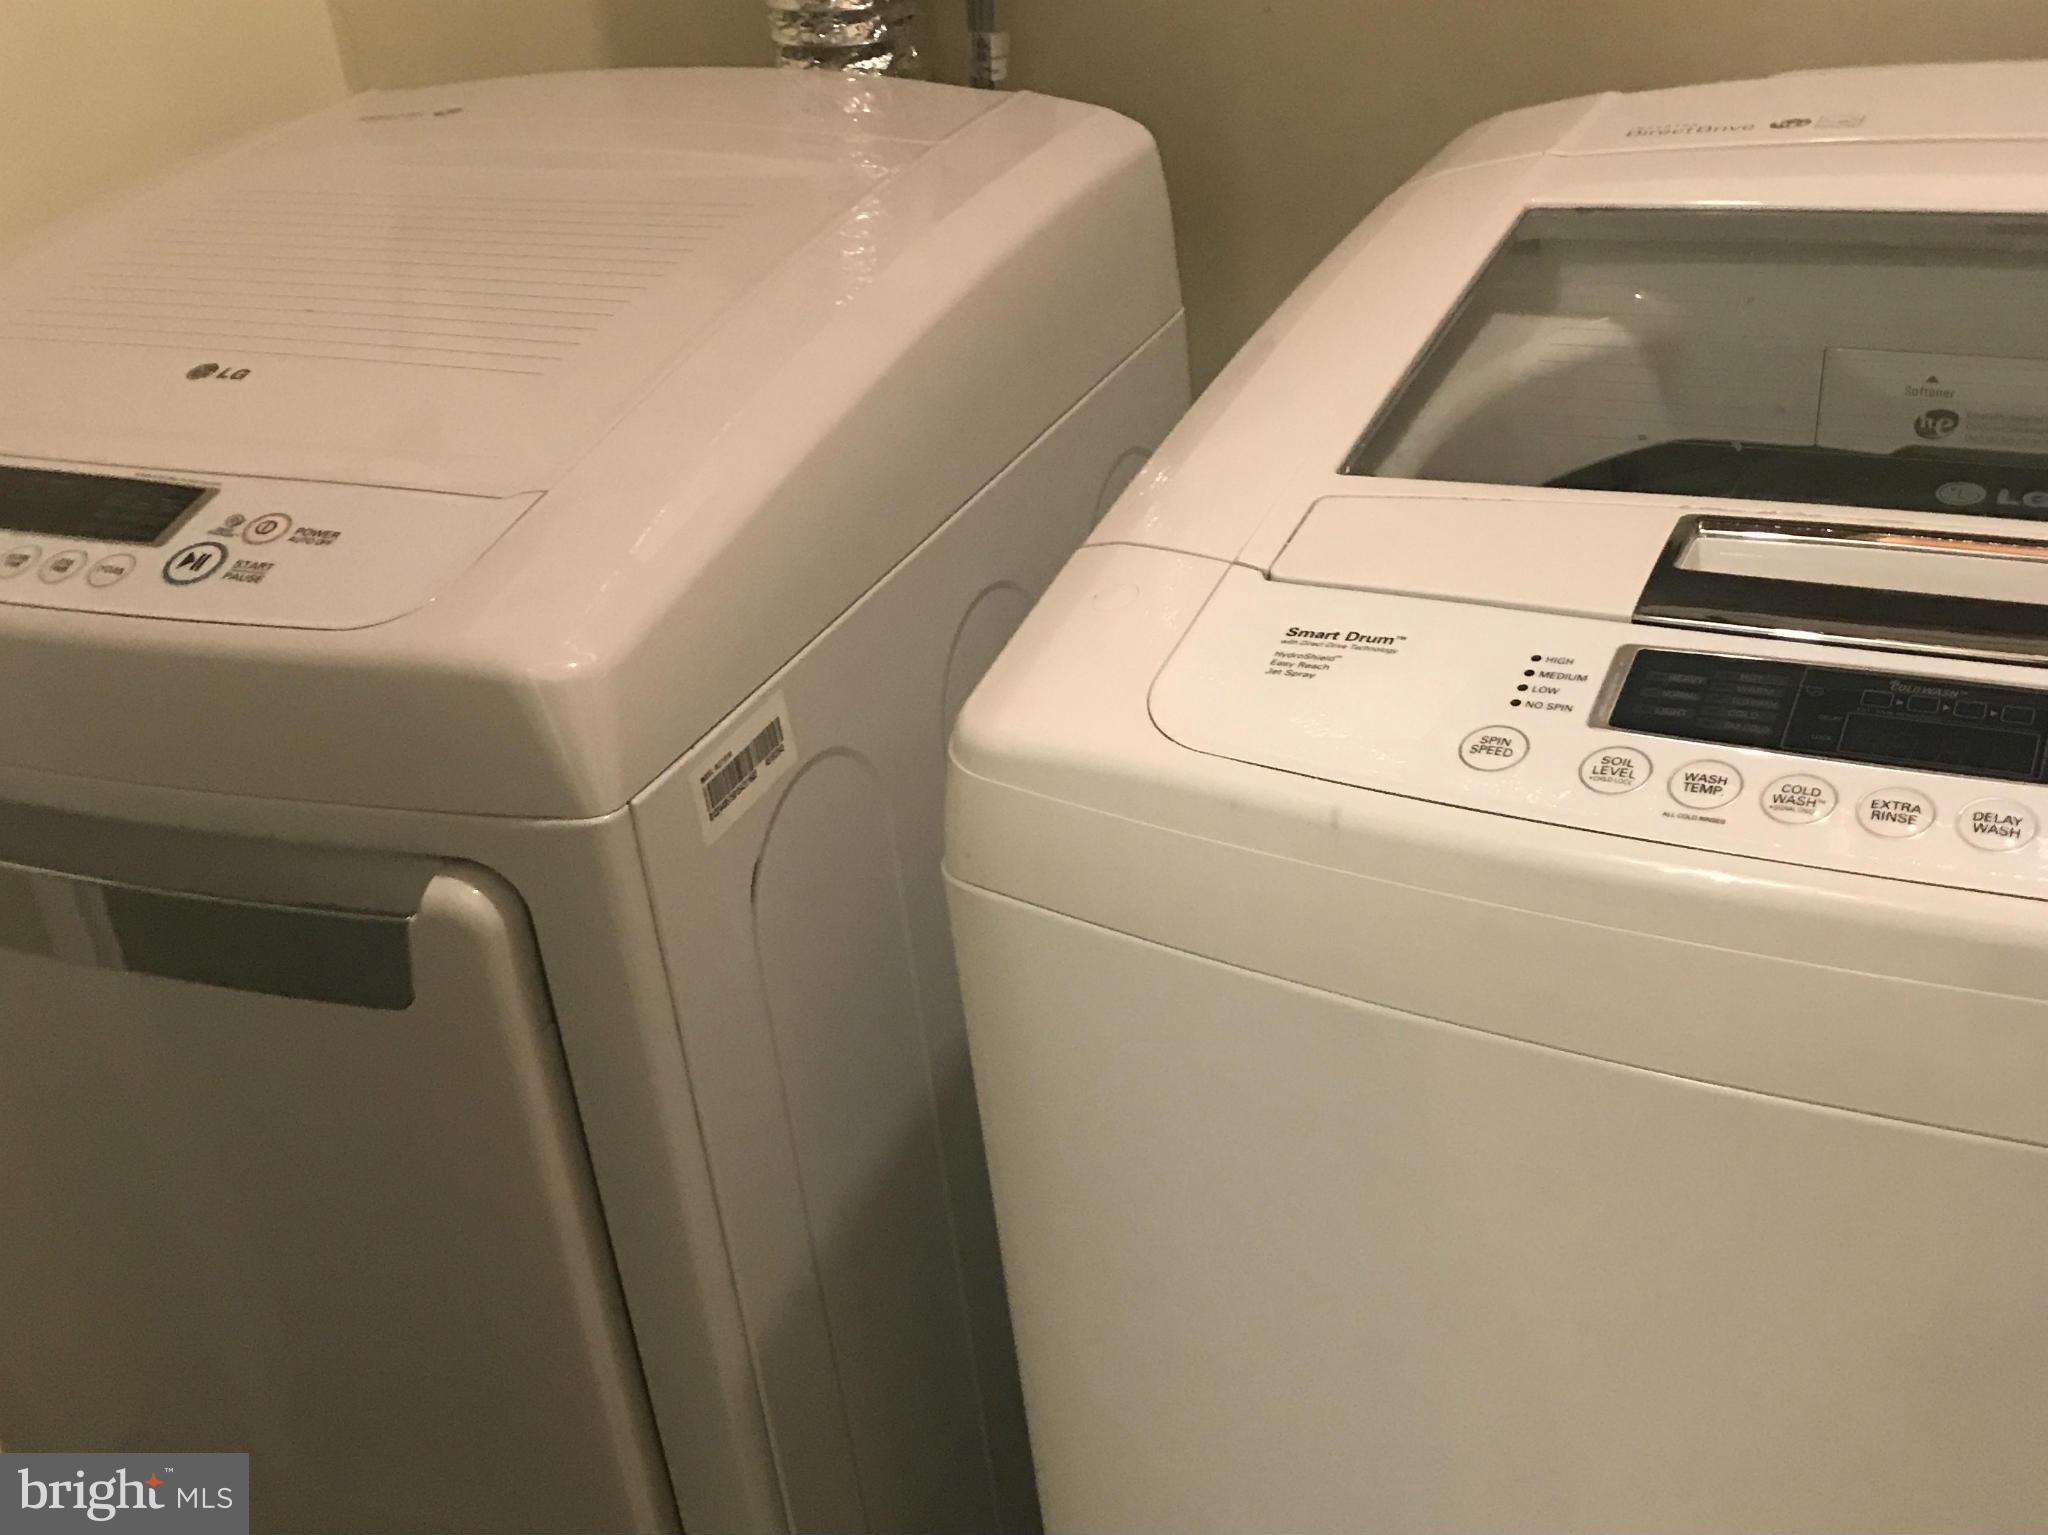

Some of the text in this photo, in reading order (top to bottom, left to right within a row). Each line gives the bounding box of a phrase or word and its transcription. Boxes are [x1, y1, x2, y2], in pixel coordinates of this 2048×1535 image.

[216, 367, 251, 380] LG
[1904, 385, 1955, 399] Softener
[294, 527, 342, 538] POWER
[232, 560, 275, 571] START
[222, 572, 265, 583] PAUSE
[1285, 627, 1341, 641] Smart
[1350, 644, 1399, 654] Technology
[1269, 659, 1330, 671] Easy Reach
[1545, 656, 1575, 665] HIGH
[1284, 669, 1316, 679] Spray
[1538, 671, 1589, 682] MEDIUM
[1531, 685, 1560, 695] LOW
[1525, 700, 1574, 712] NO SPIN
[1480, 735, 1512, 747] SPIN
[1469, 744, 1514, 758] SPEED
[1601, 755, 1634, 768] SOIL
[1592, 765, 1636, 780] LEVEL
[1684, 772, 1729, 786] WASH
[1781, 783, 1822, 797] COLD
[1870, 799, 1922, 814] EXTRA
[1677, 813, 1698, 821] COLD
[1870, 810, 1918, 825] RINSE
[1972, 811, 2023, 826] DELAY
[1973, 822, 2021, 839] WASH
